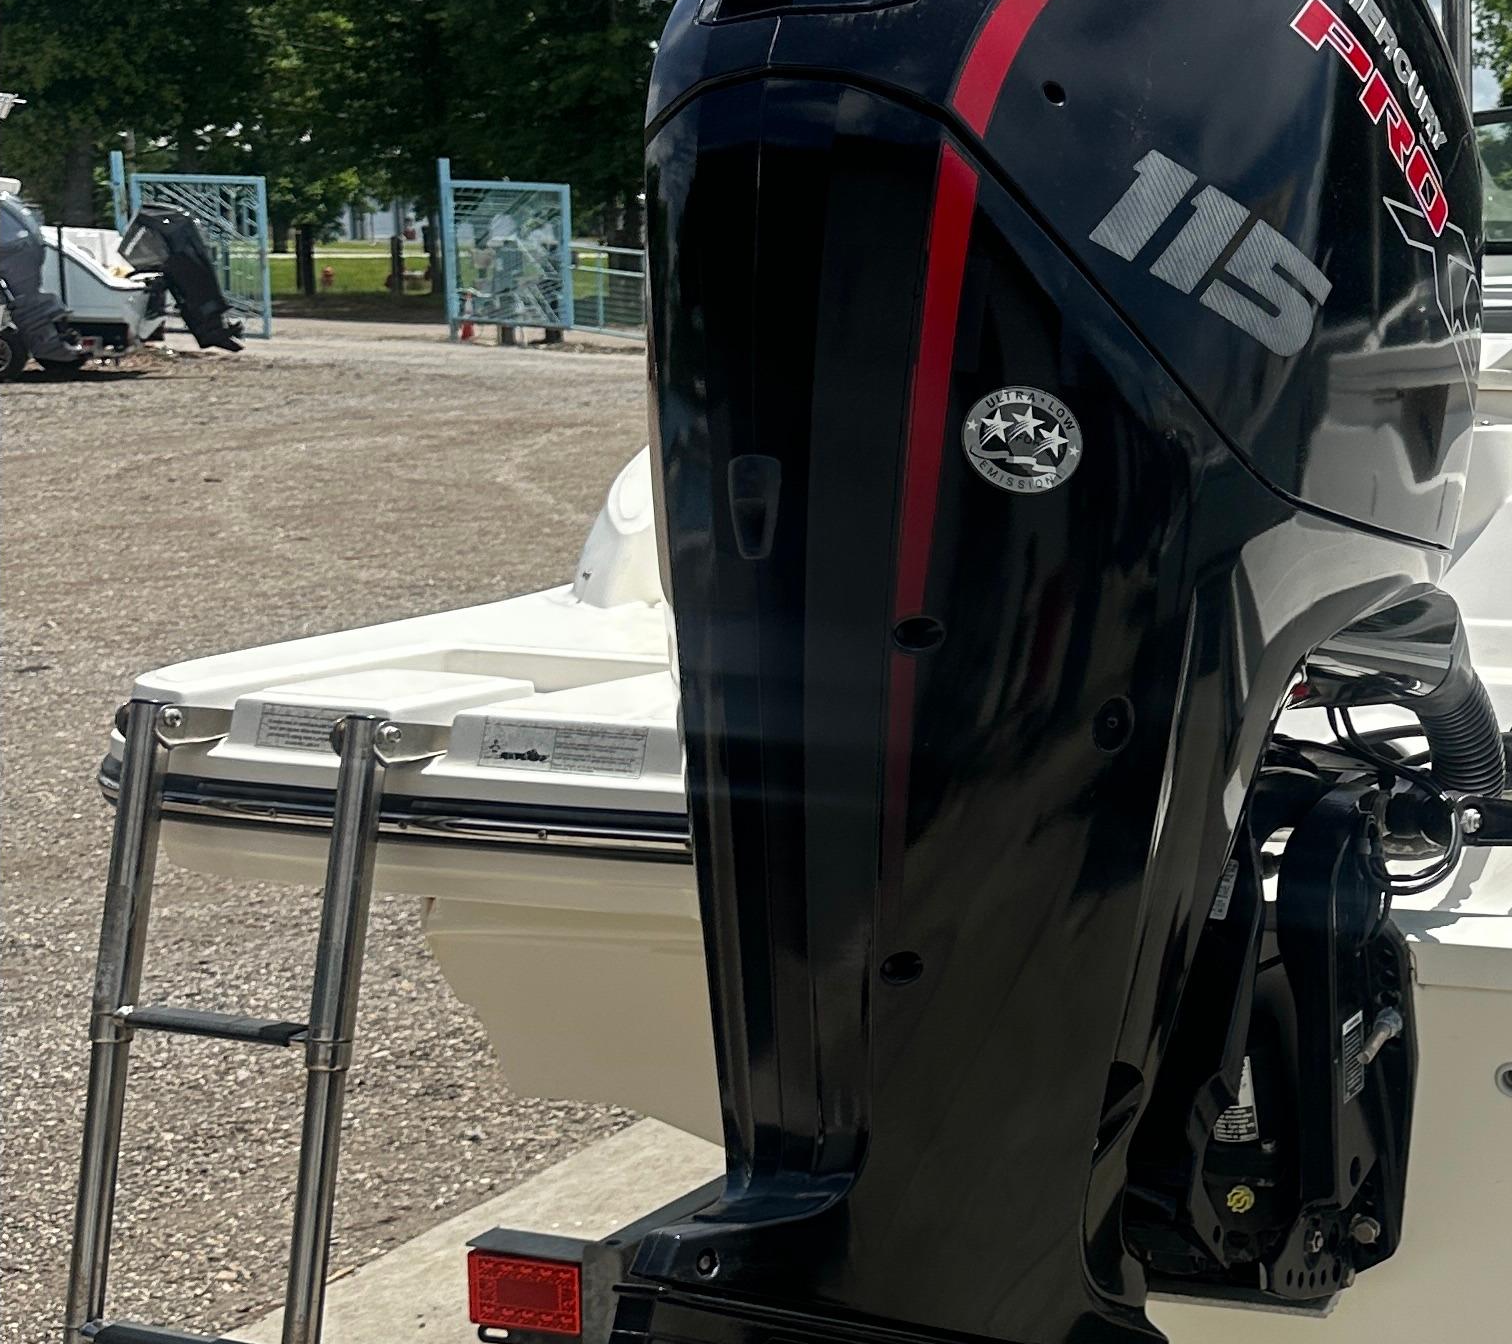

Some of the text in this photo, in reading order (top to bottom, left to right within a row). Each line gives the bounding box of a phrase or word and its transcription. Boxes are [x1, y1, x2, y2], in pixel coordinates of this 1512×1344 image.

[1088, 148, 1334, 358] 115
[986, 390, 1076, 431] ULTRA LOW
